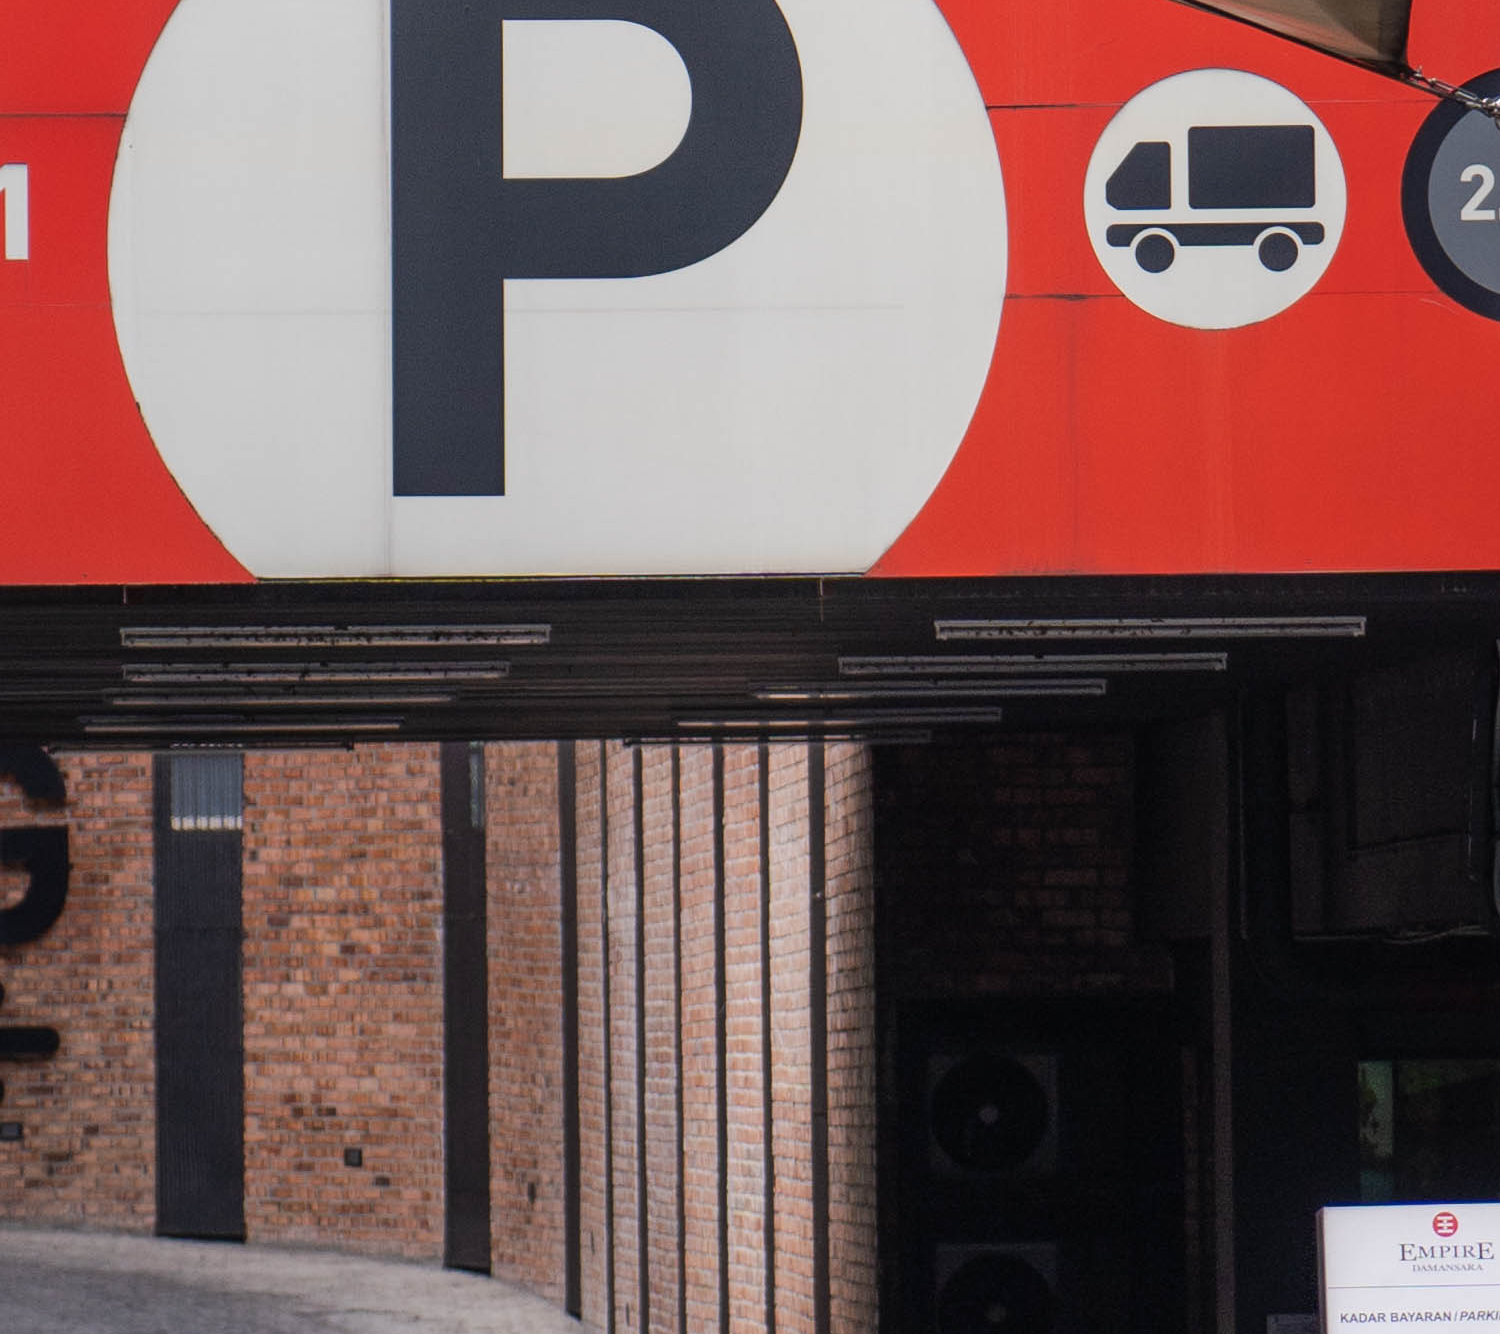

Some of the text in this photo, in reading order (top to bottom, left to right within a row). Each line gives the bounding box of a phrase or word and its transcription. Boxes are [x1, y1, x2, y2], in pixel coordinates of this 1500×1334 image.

[1400, 1242, 1494, 1261] EMPIRE
[1412, 1264, 1483, 1272] DAMANSARA
[1340, 1313, 1386, 1323] KADAR
[1391, 1312, 1451, 1322] BAYARAN
